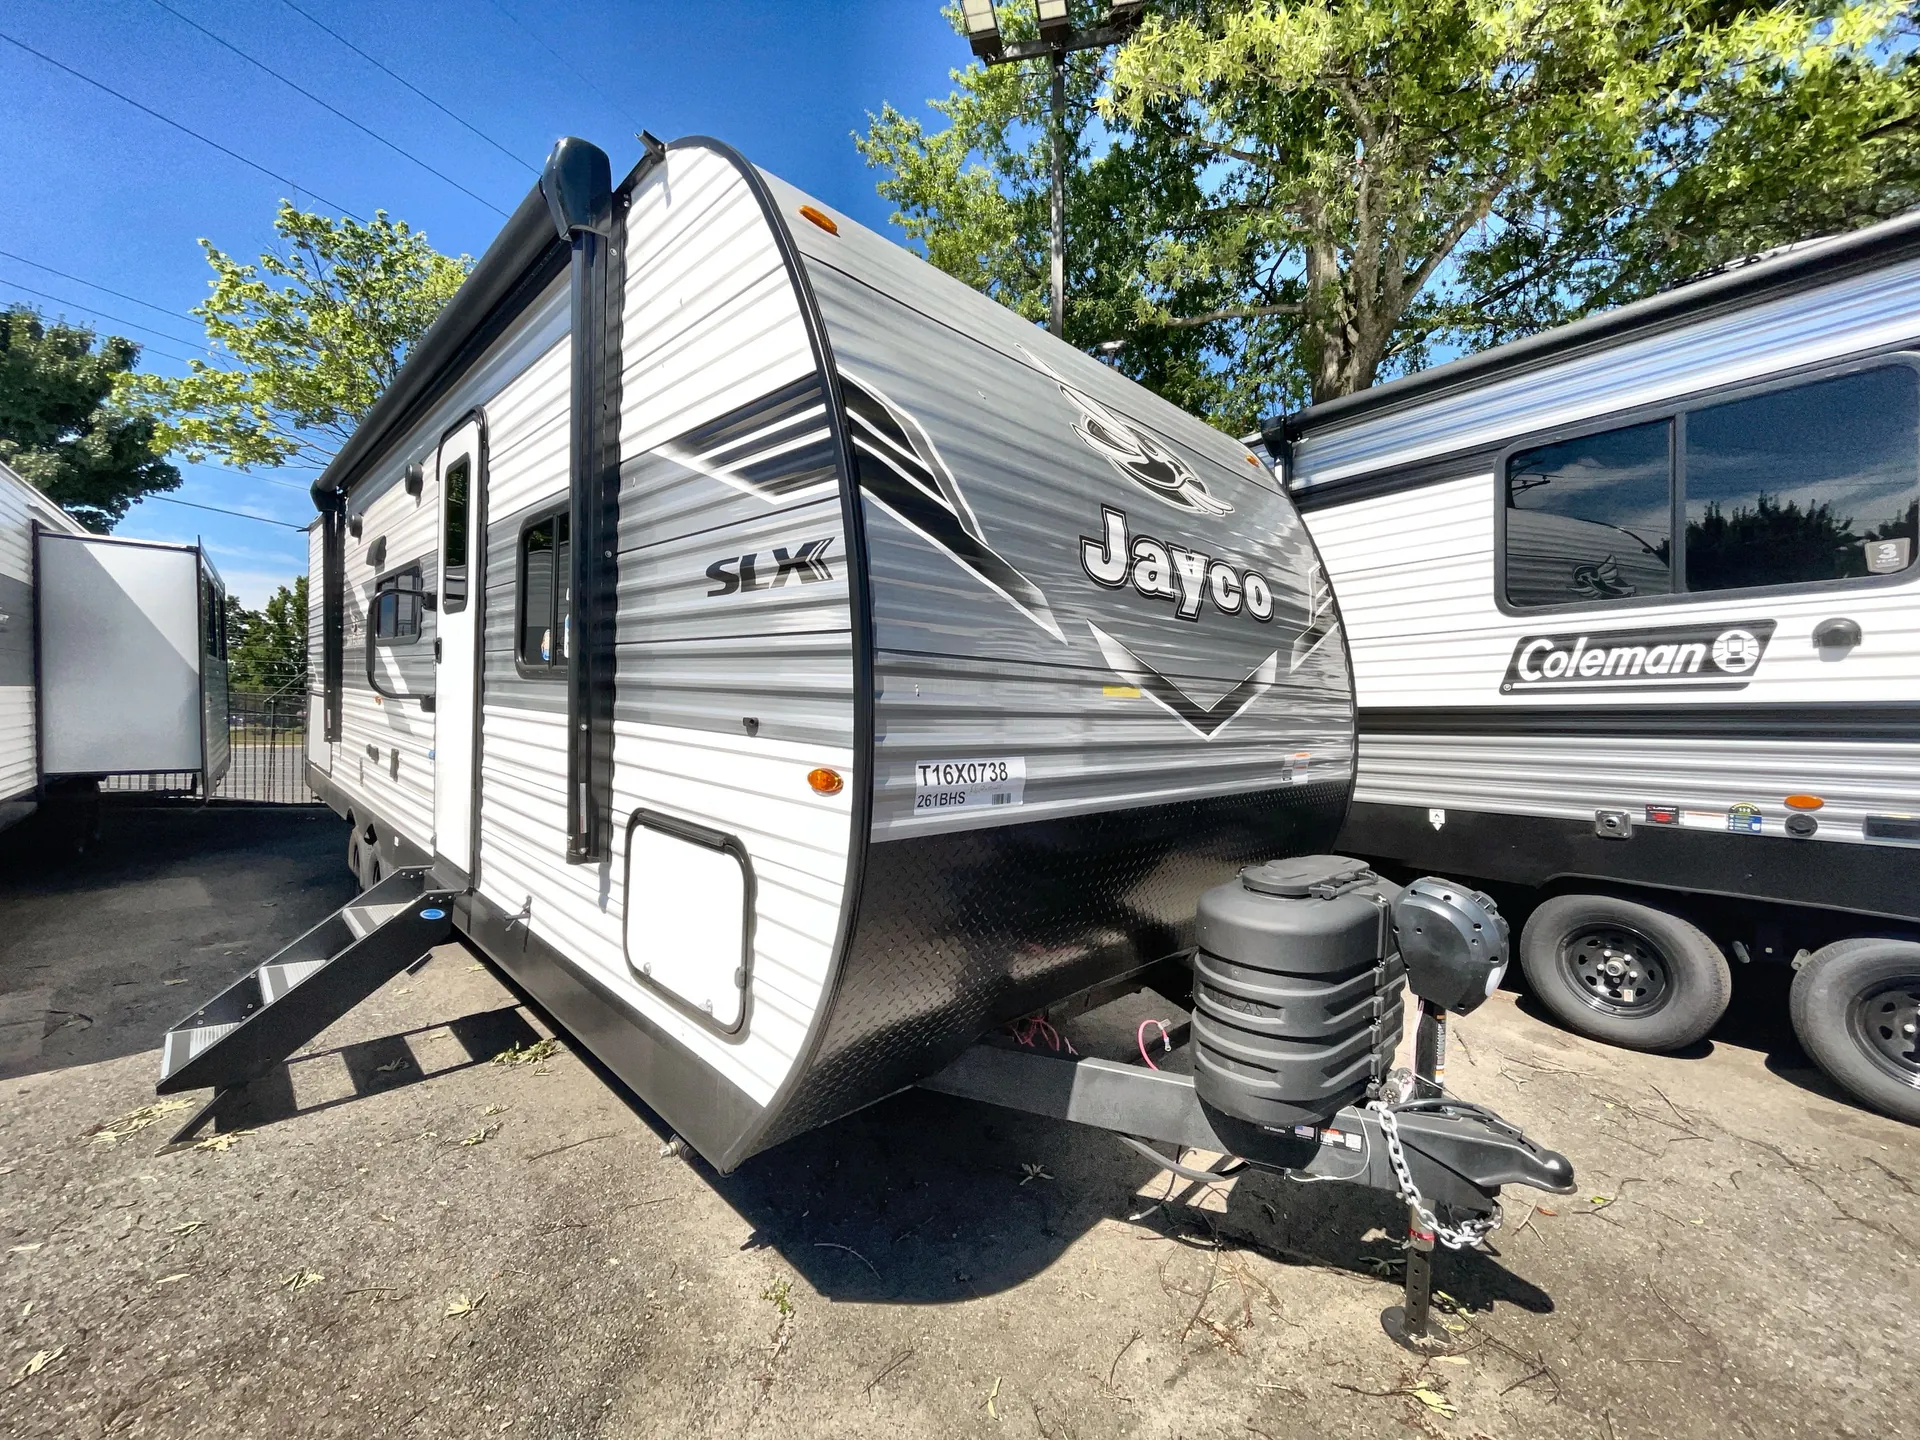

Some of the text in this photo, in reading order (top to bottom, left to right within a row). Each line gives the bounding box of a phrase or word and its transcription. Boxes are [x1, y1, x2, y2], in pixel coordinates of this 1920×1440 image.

[706, 536, 836, 597] SLX
[1079, 503, 1275, 623] Jayco
[1878, 543, 1898, 559] 3
[1518, 636, 1707, 682] Coleman
[918, 762, 1008, 786] T16X0738
[917, 791, 966, 808] 261BHS
